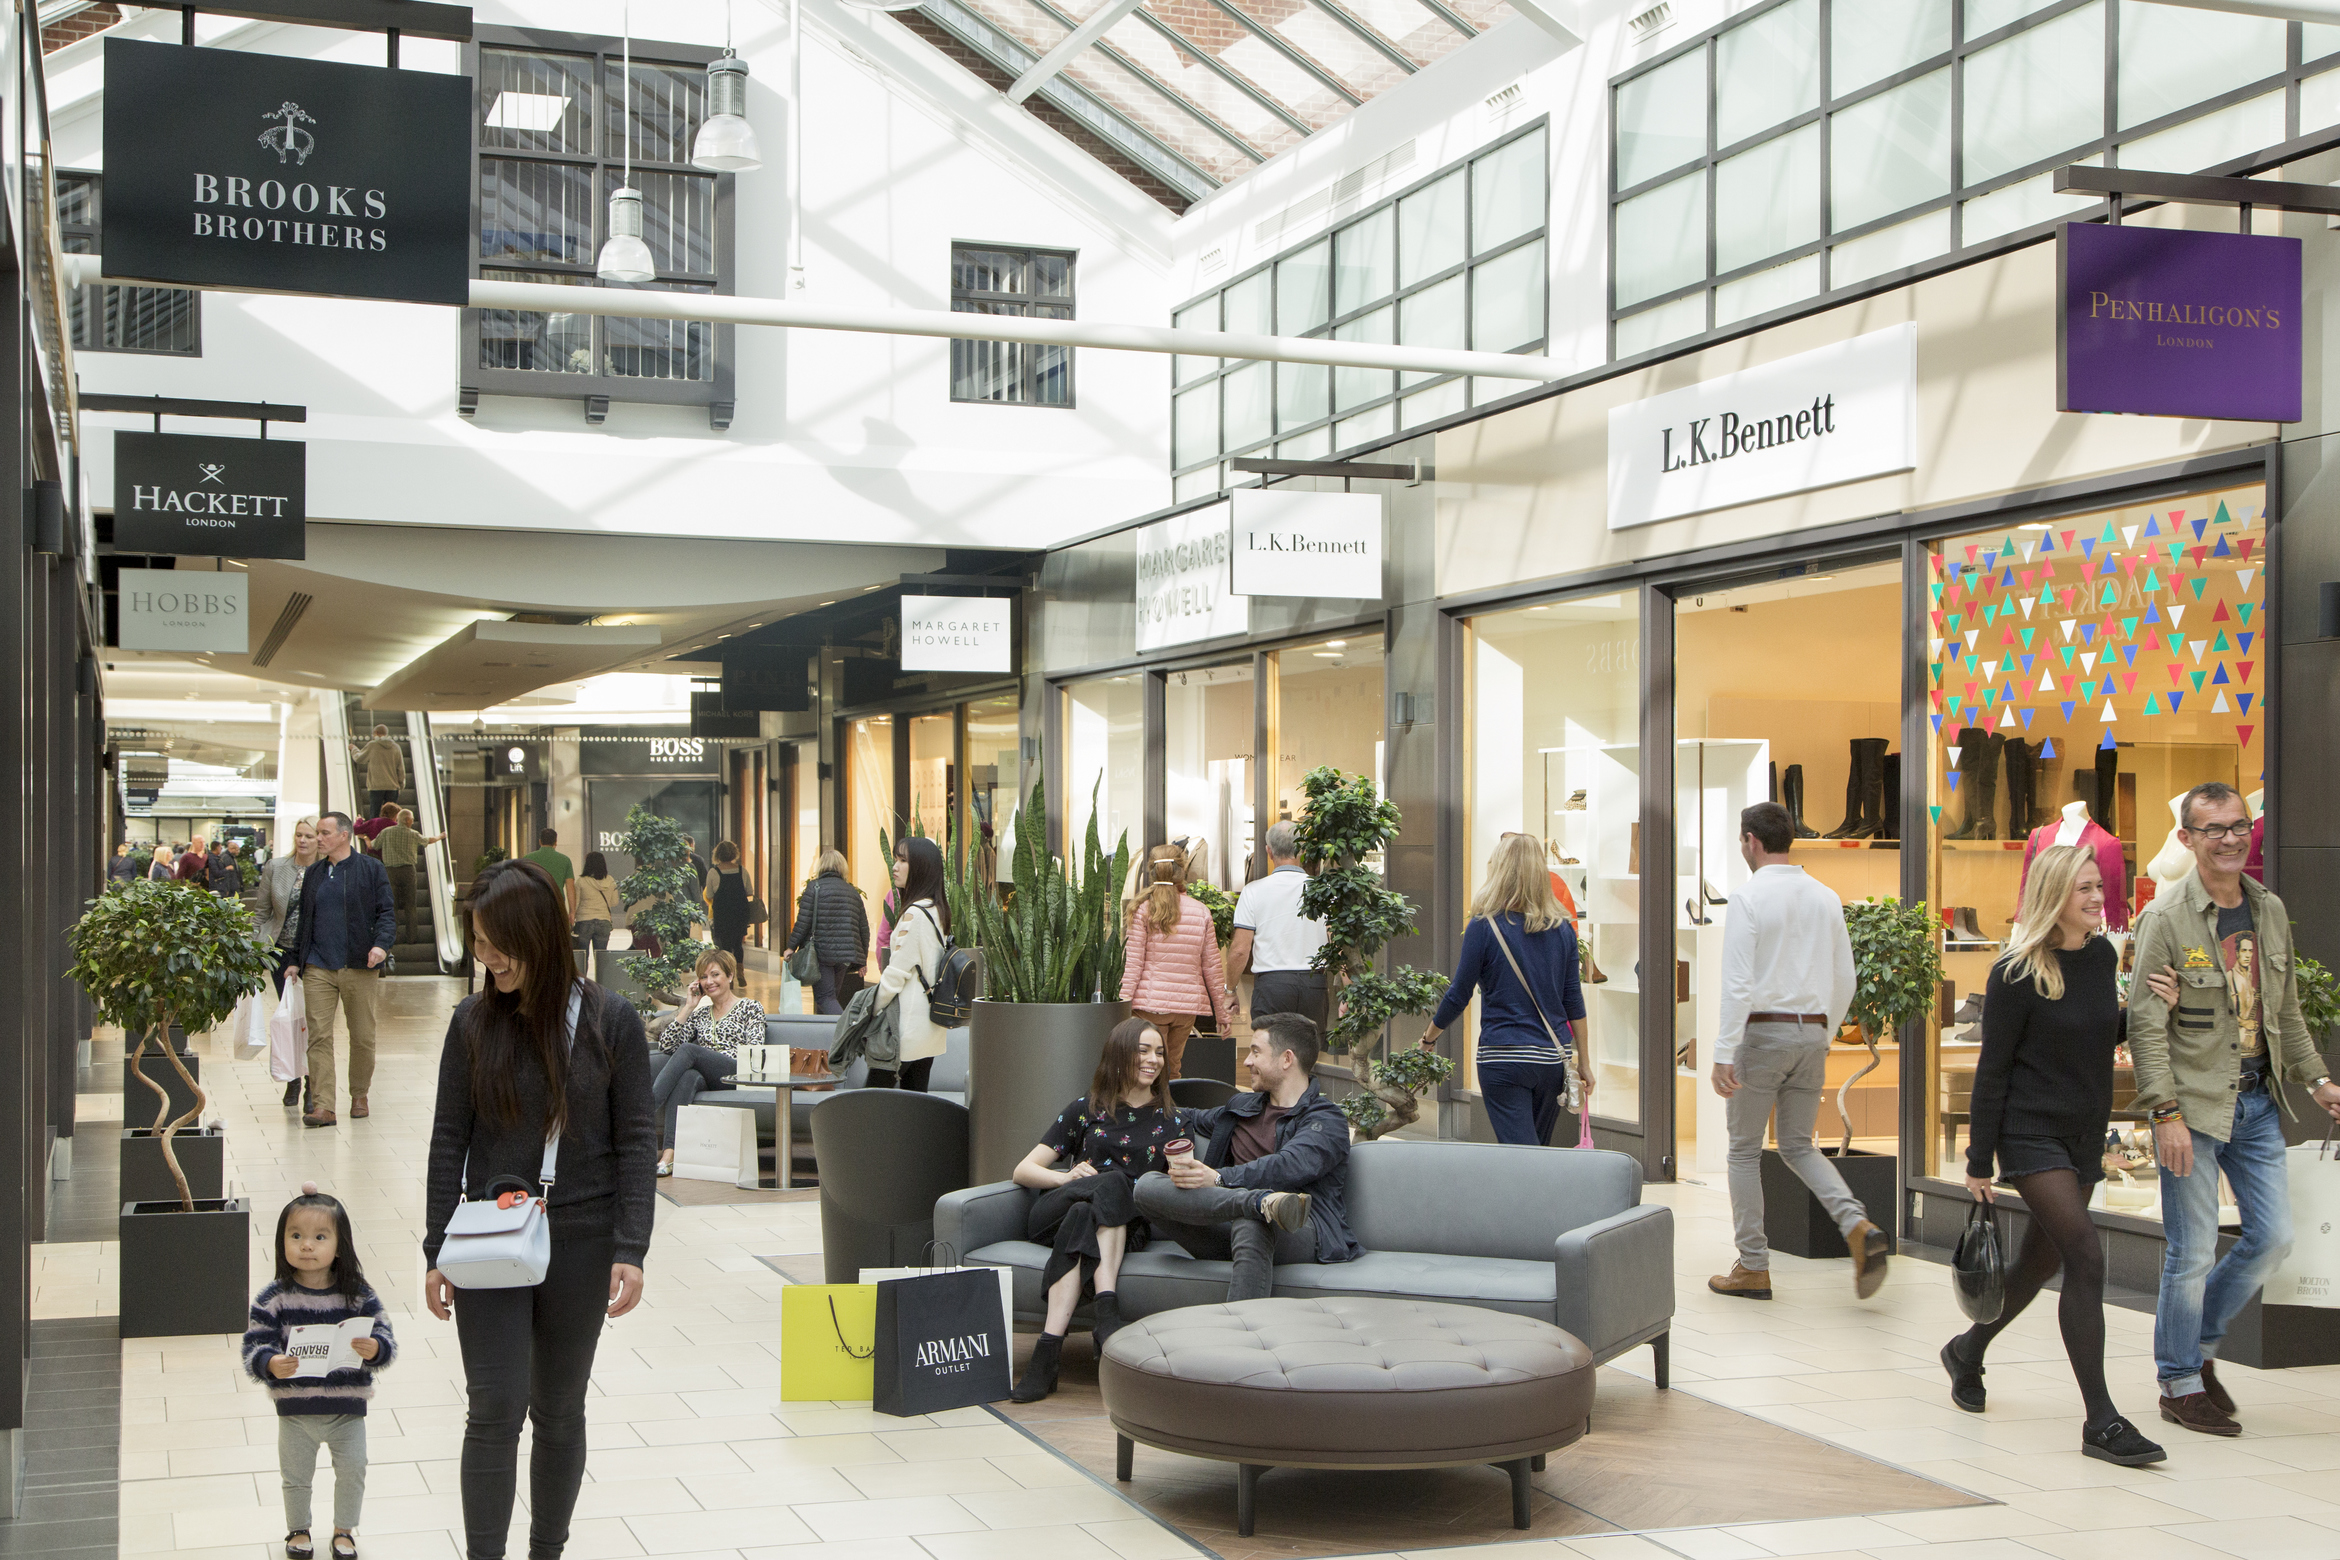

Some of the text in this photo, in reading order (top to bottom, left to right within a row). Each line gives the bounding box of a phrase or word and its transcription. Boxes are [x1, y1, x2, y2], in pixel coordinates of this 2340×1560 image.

[193, 173, 388, 220] BROOKS
[193, 212, 387, 252] BROTHERS
[2089, 291, 2281, 329] PENHALIGON'S
[2156, 334, 2214, 349] LONDON
[1660, 393, 1836, 474] L.K.Bennett
[132, 484, 288, 518] HACKETT
[185, 517, 236, 529] LONDON
[1247, 531, 1368, 555] L.K.Bennett
[132, 591, 237, 615] HOBBS
[1138, 582, 1212, 626] HOWELL
[912, 620, 1000, 632] MARGARET
[912, 635, 979, 646] HOWELL
[697, 710, 754, 718] MICHAEL KORS
[650, 737, 704, 756] BOSS
[509, 763, 524, 772] Lift
[599, 831, 633, 847] BO
[2298, 1276, 2331, 1286] MOLTON
[2296, 1286, 2329, 1296] BROWN
[289, 1345, 329, 1357] BRANDS
[915, 1332, 990, 1367] ARMANI
[935, 1362, 971, 1376] OUTLET
